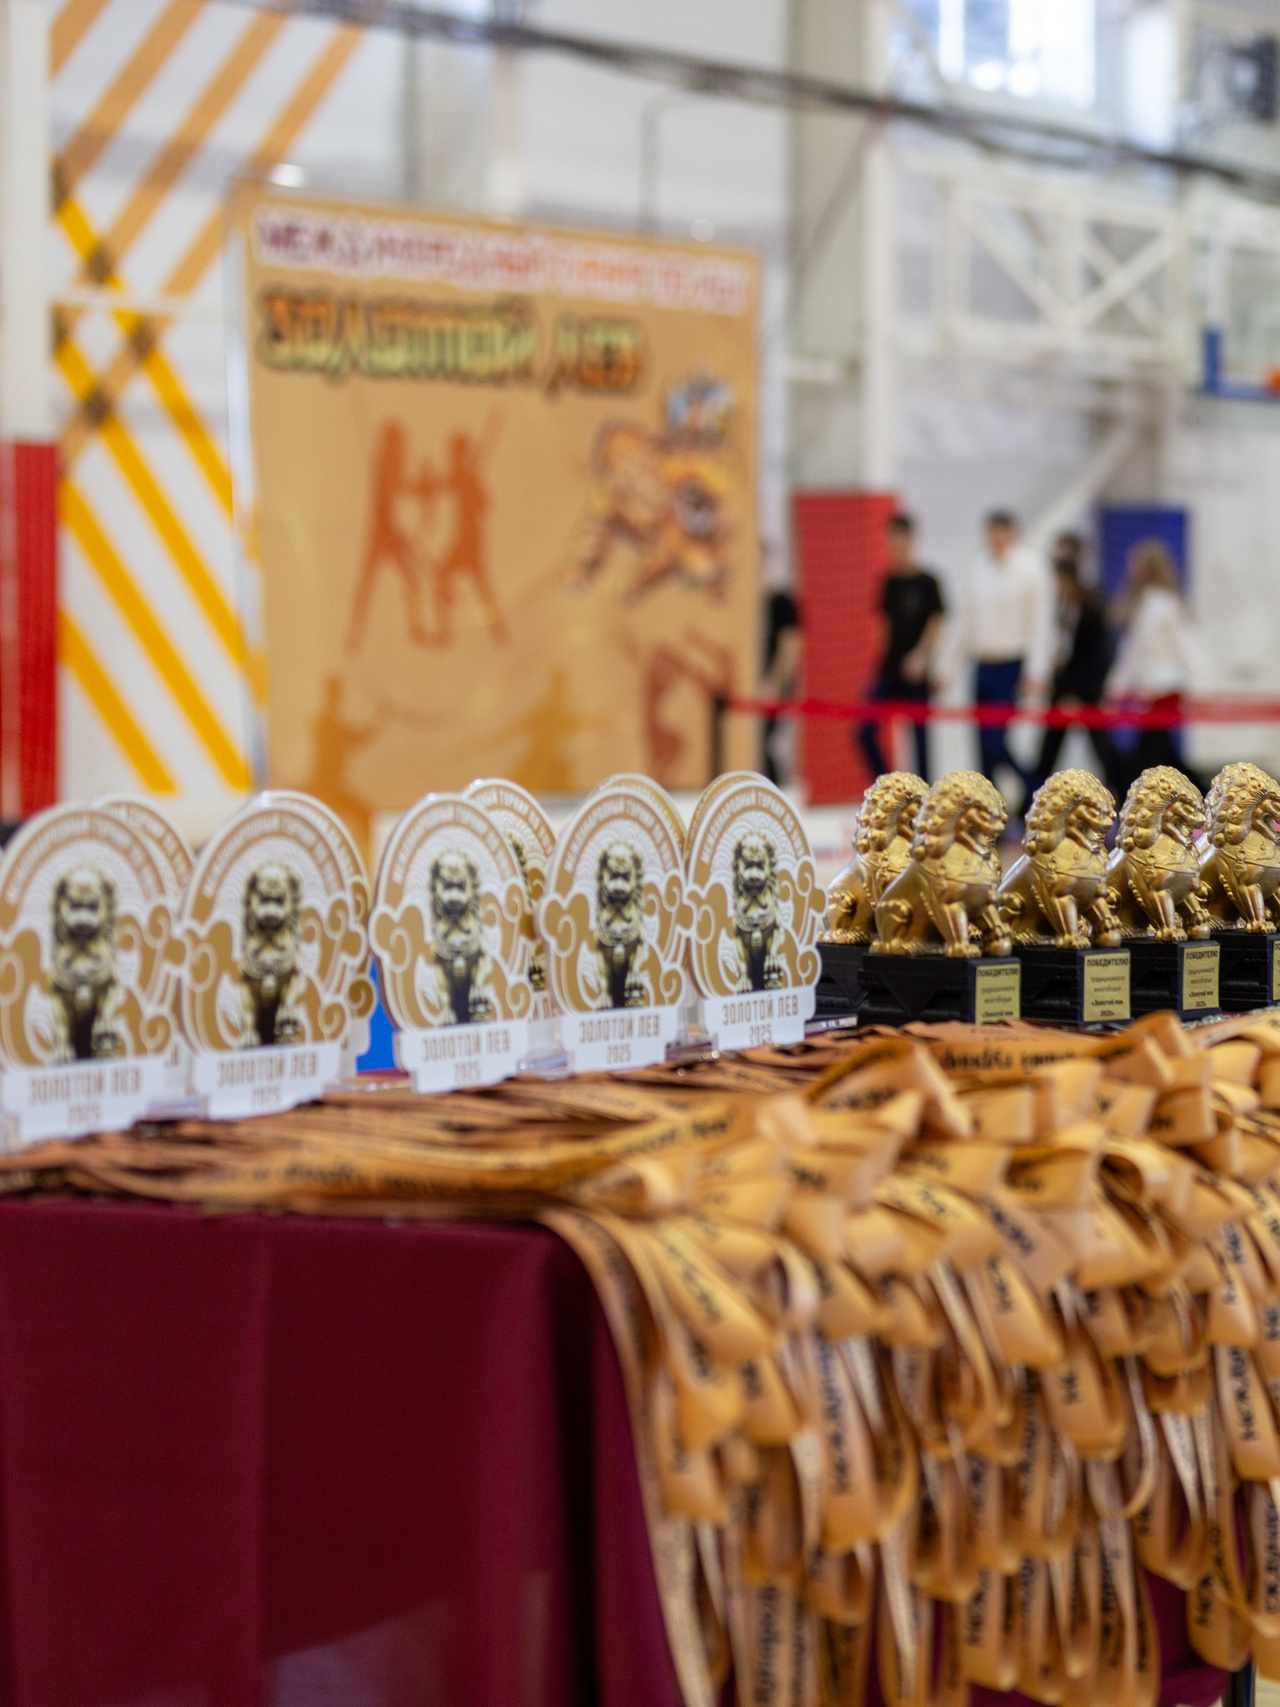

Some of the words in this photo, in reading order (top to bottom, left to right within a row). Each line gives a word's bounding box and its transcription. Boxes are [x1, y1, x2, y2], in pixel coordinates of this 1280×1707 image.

[1086, 957, 1129, 968] ПОБЕДИТЕЛЮ
[1186, 949, 1218, 961] ПОБЕДИТЕЛЮ
[722, 997, 773, 1026] ЗОЛОТОЙ
[777, 995, 799, 1017] ЛЕВ
[579, 1014, 634, 1044] ЗОЛОТОЙ
[637, 1015, 660, 1038] ЛЕВ
